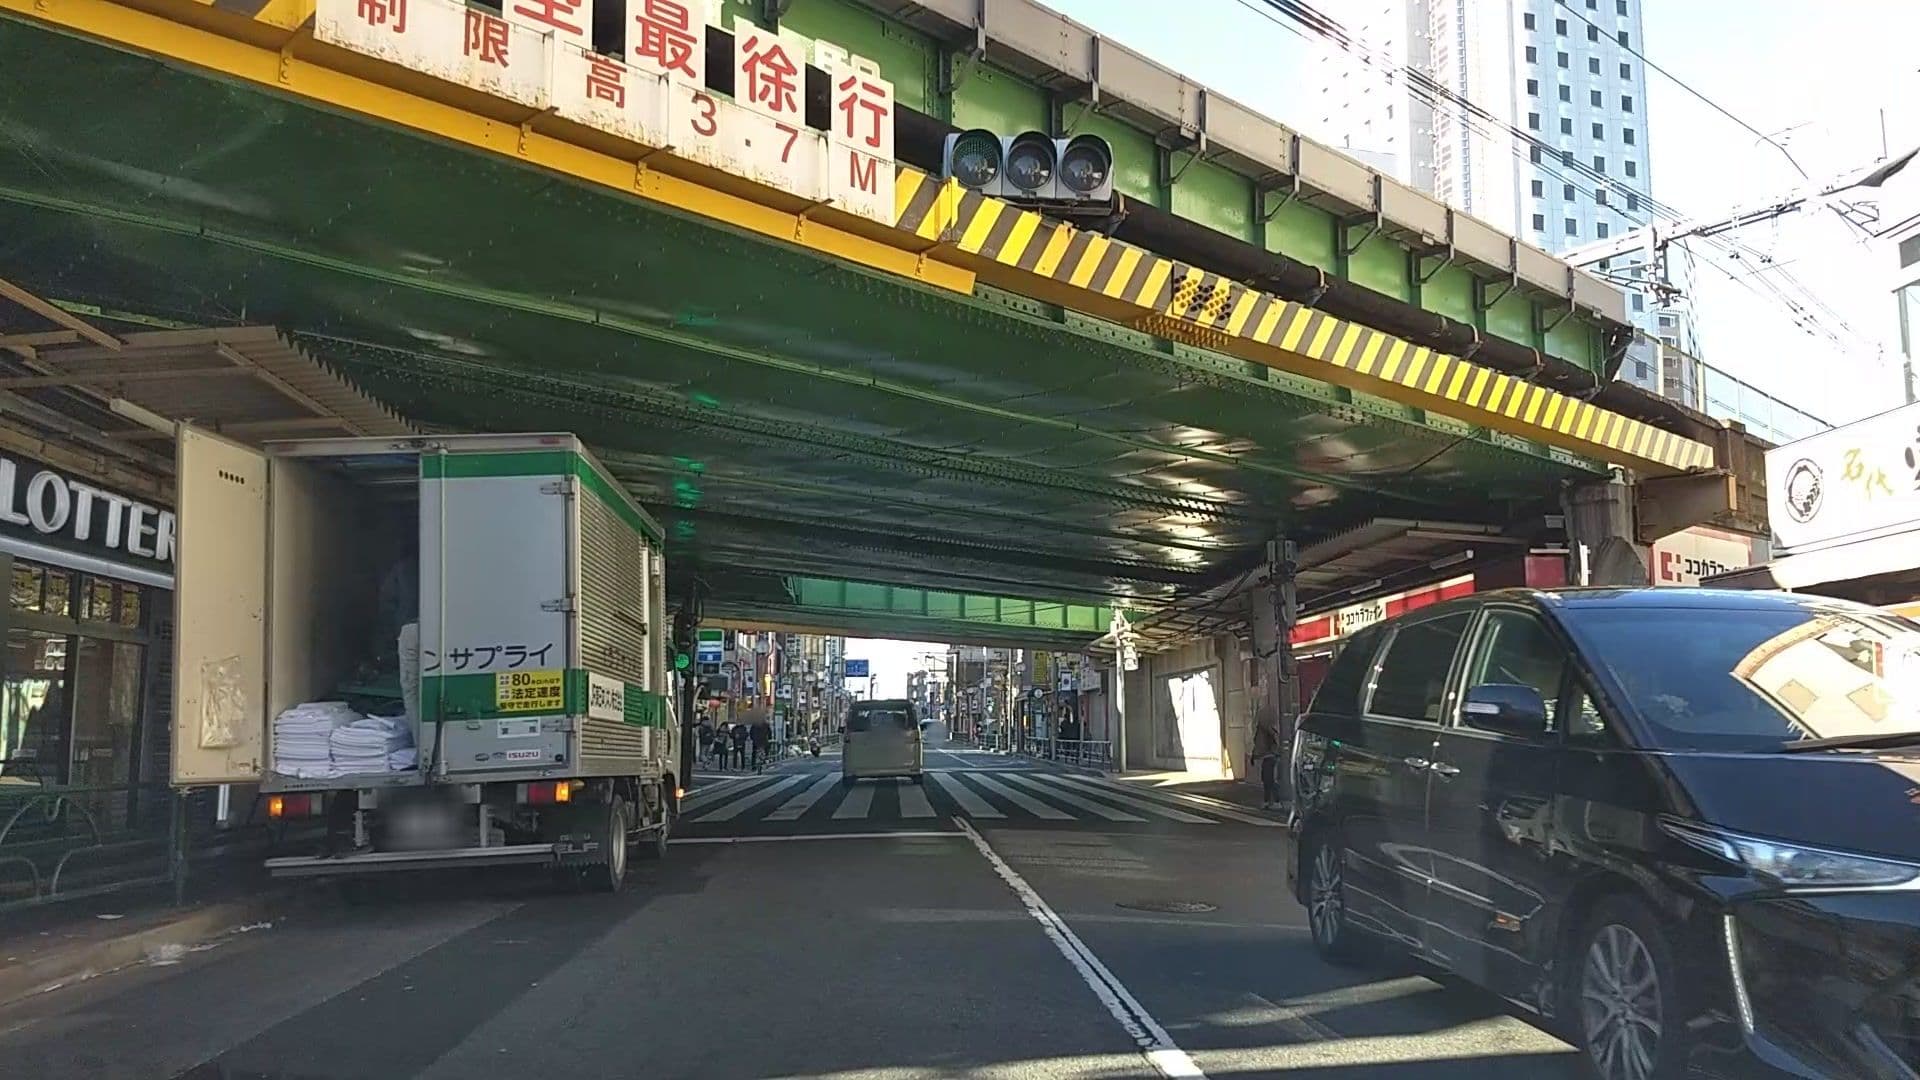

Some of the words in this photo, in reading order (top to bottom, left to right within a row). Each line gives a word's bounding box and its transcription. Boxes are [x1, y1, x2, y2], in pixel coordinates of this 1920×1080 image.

[1346, 605, 1383, 627] ココカラファイン
[424, 642, 553, 672] ンサプライ
[512, 673, 531, 686] 80
[511, 686, 561, 700] 法定速度
[508, 751, 539, 759] ISUZU
